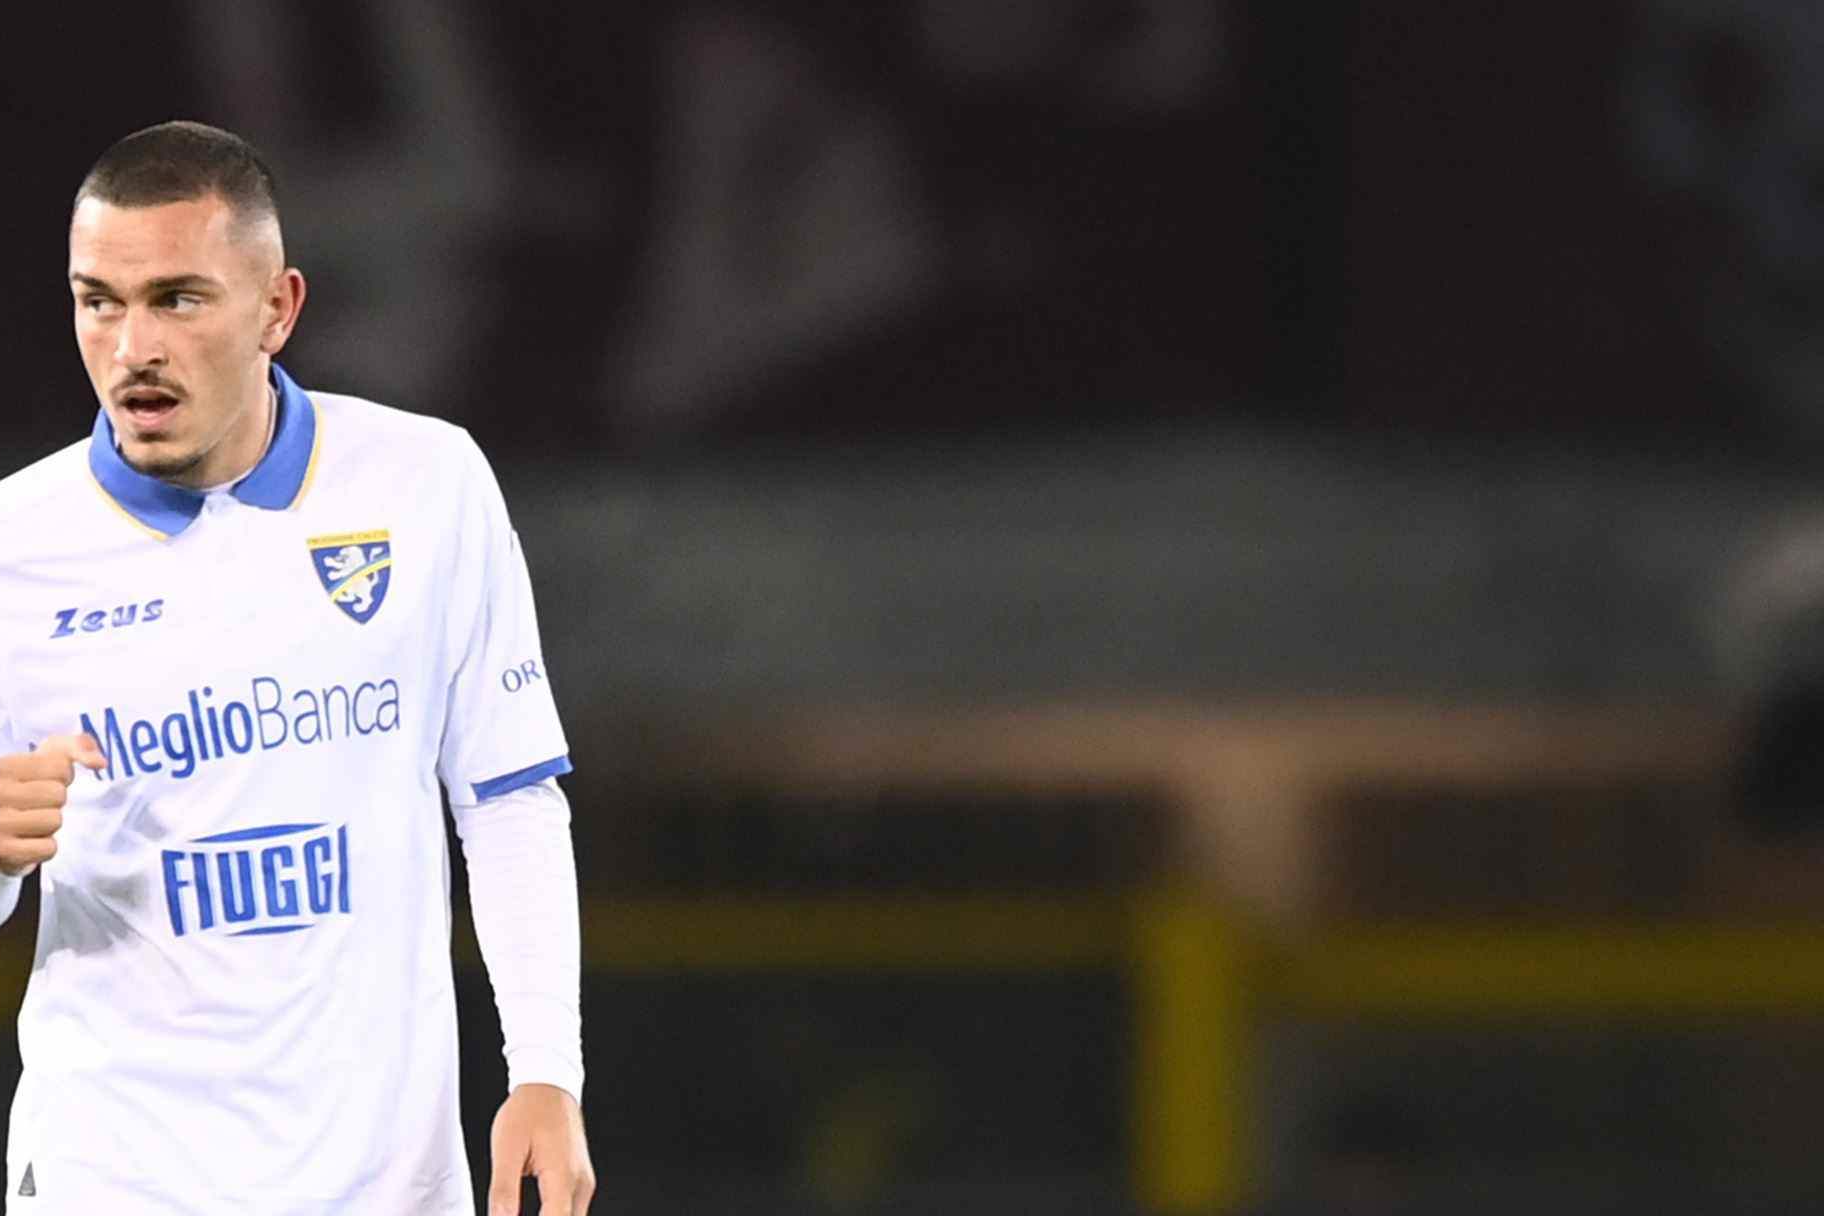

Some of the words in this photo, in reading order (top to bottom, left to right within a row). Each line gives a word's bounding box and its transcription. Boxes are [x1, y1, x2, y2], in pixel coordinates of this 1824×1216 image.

[48, 598, 165, 640] Zeus
[78, 676, 401, 782] MeglioBanca
[160, 823, 351, 938] FIUGGI
